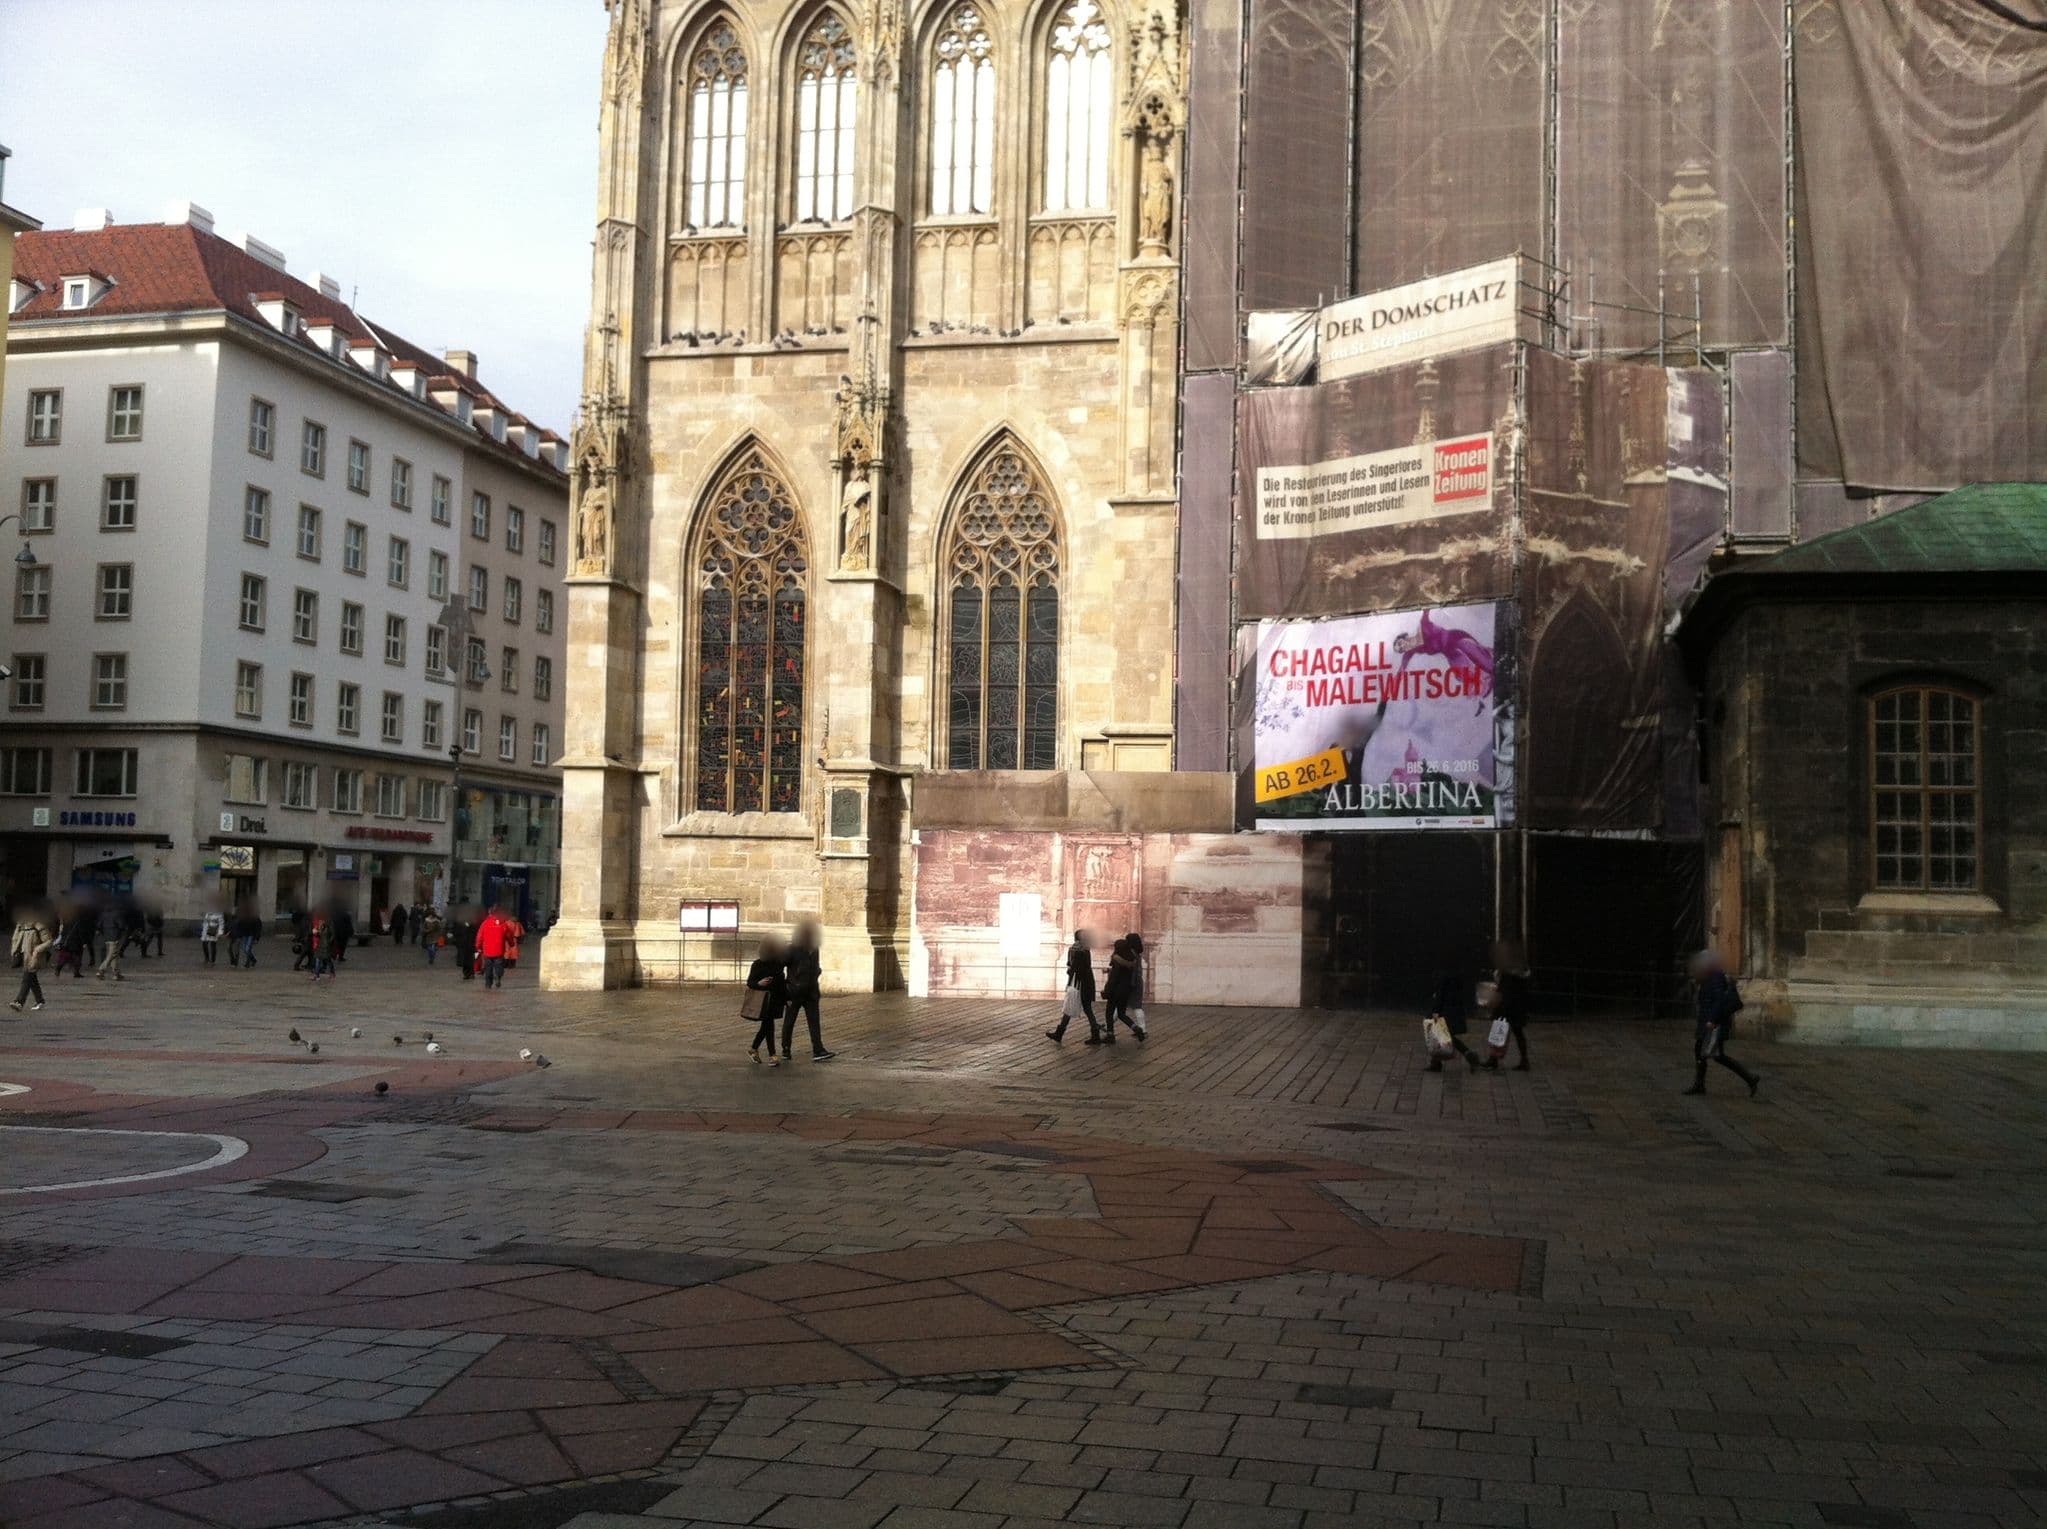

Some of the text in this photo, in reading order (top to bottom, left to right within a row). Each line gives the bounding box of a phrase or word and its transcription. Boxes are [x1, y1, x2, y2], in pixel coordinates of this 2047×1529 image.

[1325, 280, 1507, 342] DER DOMSCHATZ
[1263, 478, 1280, 492] Die
[1350, 467, 1367, 481] des
[1369, 458, 1422, 478] Singertores
[1435, 448, 1487, 472] Kronen
[1264, 494, 1286, 508] wird
[1290, 495, 1308, 507] von
[1327, 484, 1377, 502] Leserinnen
[1379, 478, 1397, 494] und
[1400, 474, 1430, 491] Lesern
[1435, 471, 1486, 494] Zeitung
[1263, 512, 1280, 525] der
[1318, 505, 1350, 521] Zeitung
[1269, 641, 1392, 678] CHAGALL
[1286, 666, 1482, 708] BIS MALEWITSCH
[1265, 758, 1337, 793] AB 26.2.
[1406, 761, 1423, 774] BIS
[1323, 779, 1483, 811] ALBERTINA
[59, 810, 137, 826] SAMSUNG
[240, 815, 268, 834] Drei.
